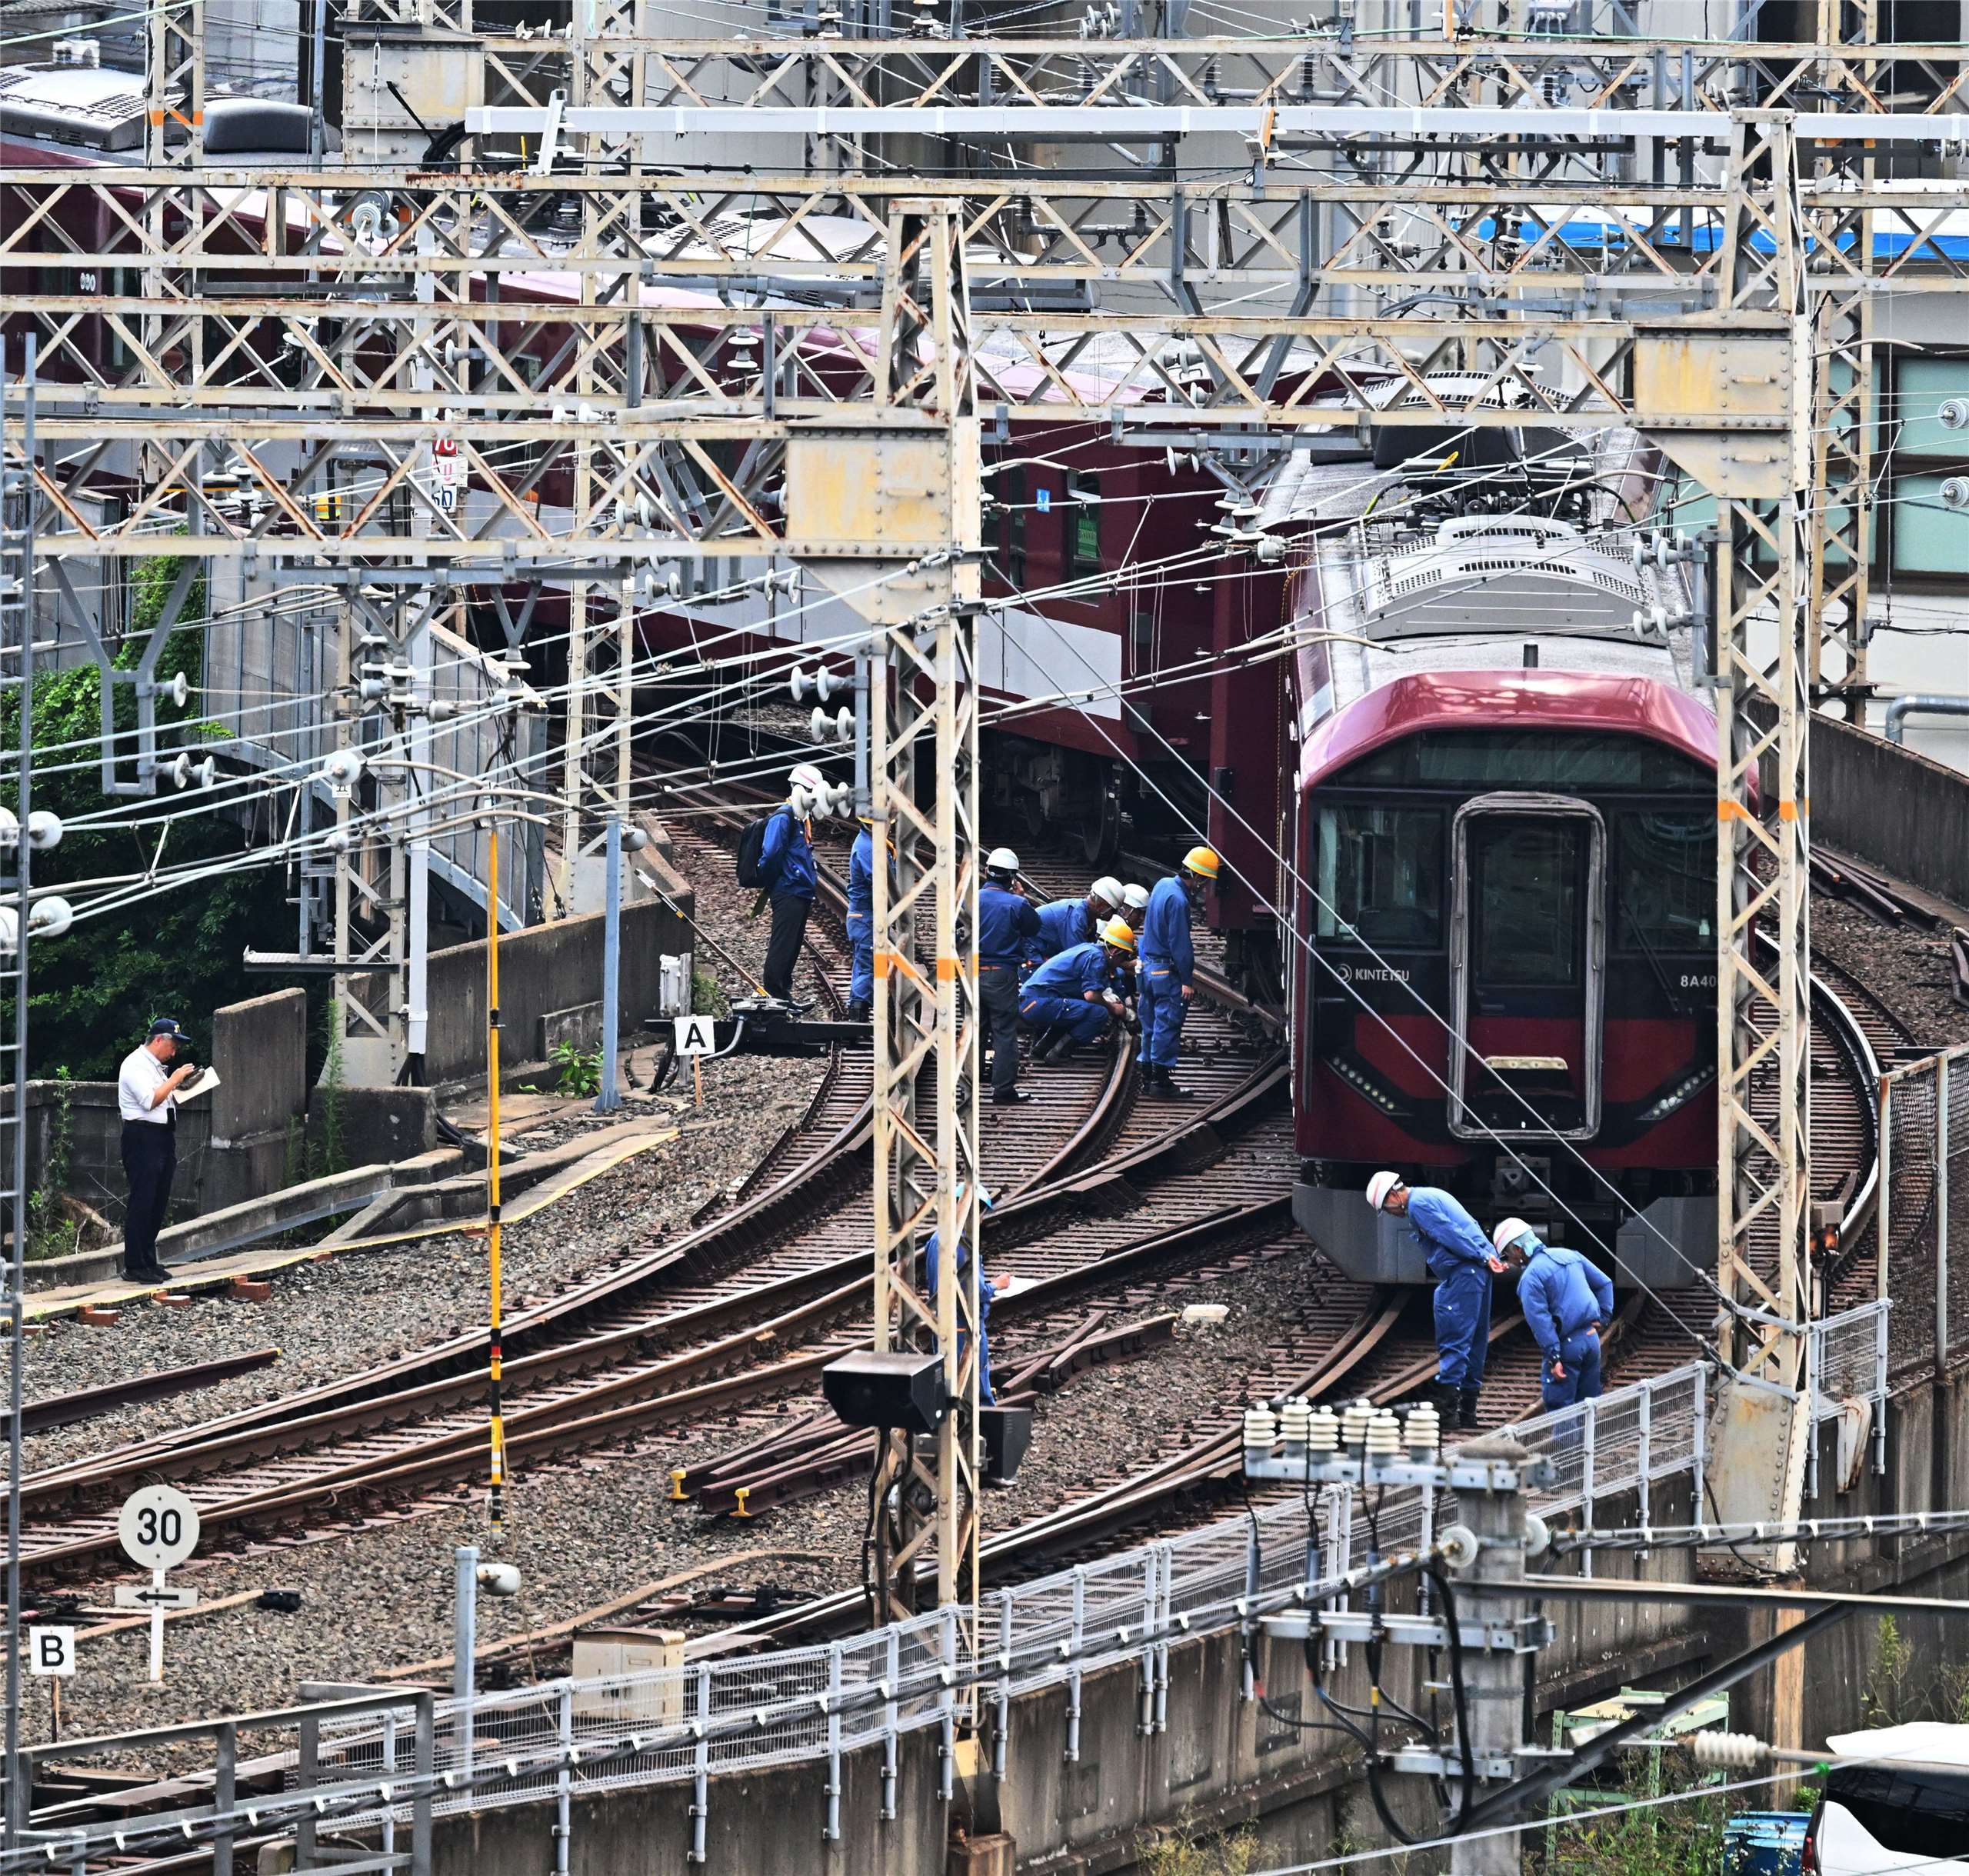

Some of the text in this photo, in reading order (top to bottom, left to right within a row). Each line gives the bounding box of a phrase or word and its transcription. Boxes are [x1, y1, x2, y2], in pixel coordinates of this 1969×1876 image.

[1355, 968, 1410, 981] KINTETSU
[684, 1022, 707, 1049] A
[137, 1507, 182, 1547] 30
[40, 1634, 65, 1668] B
